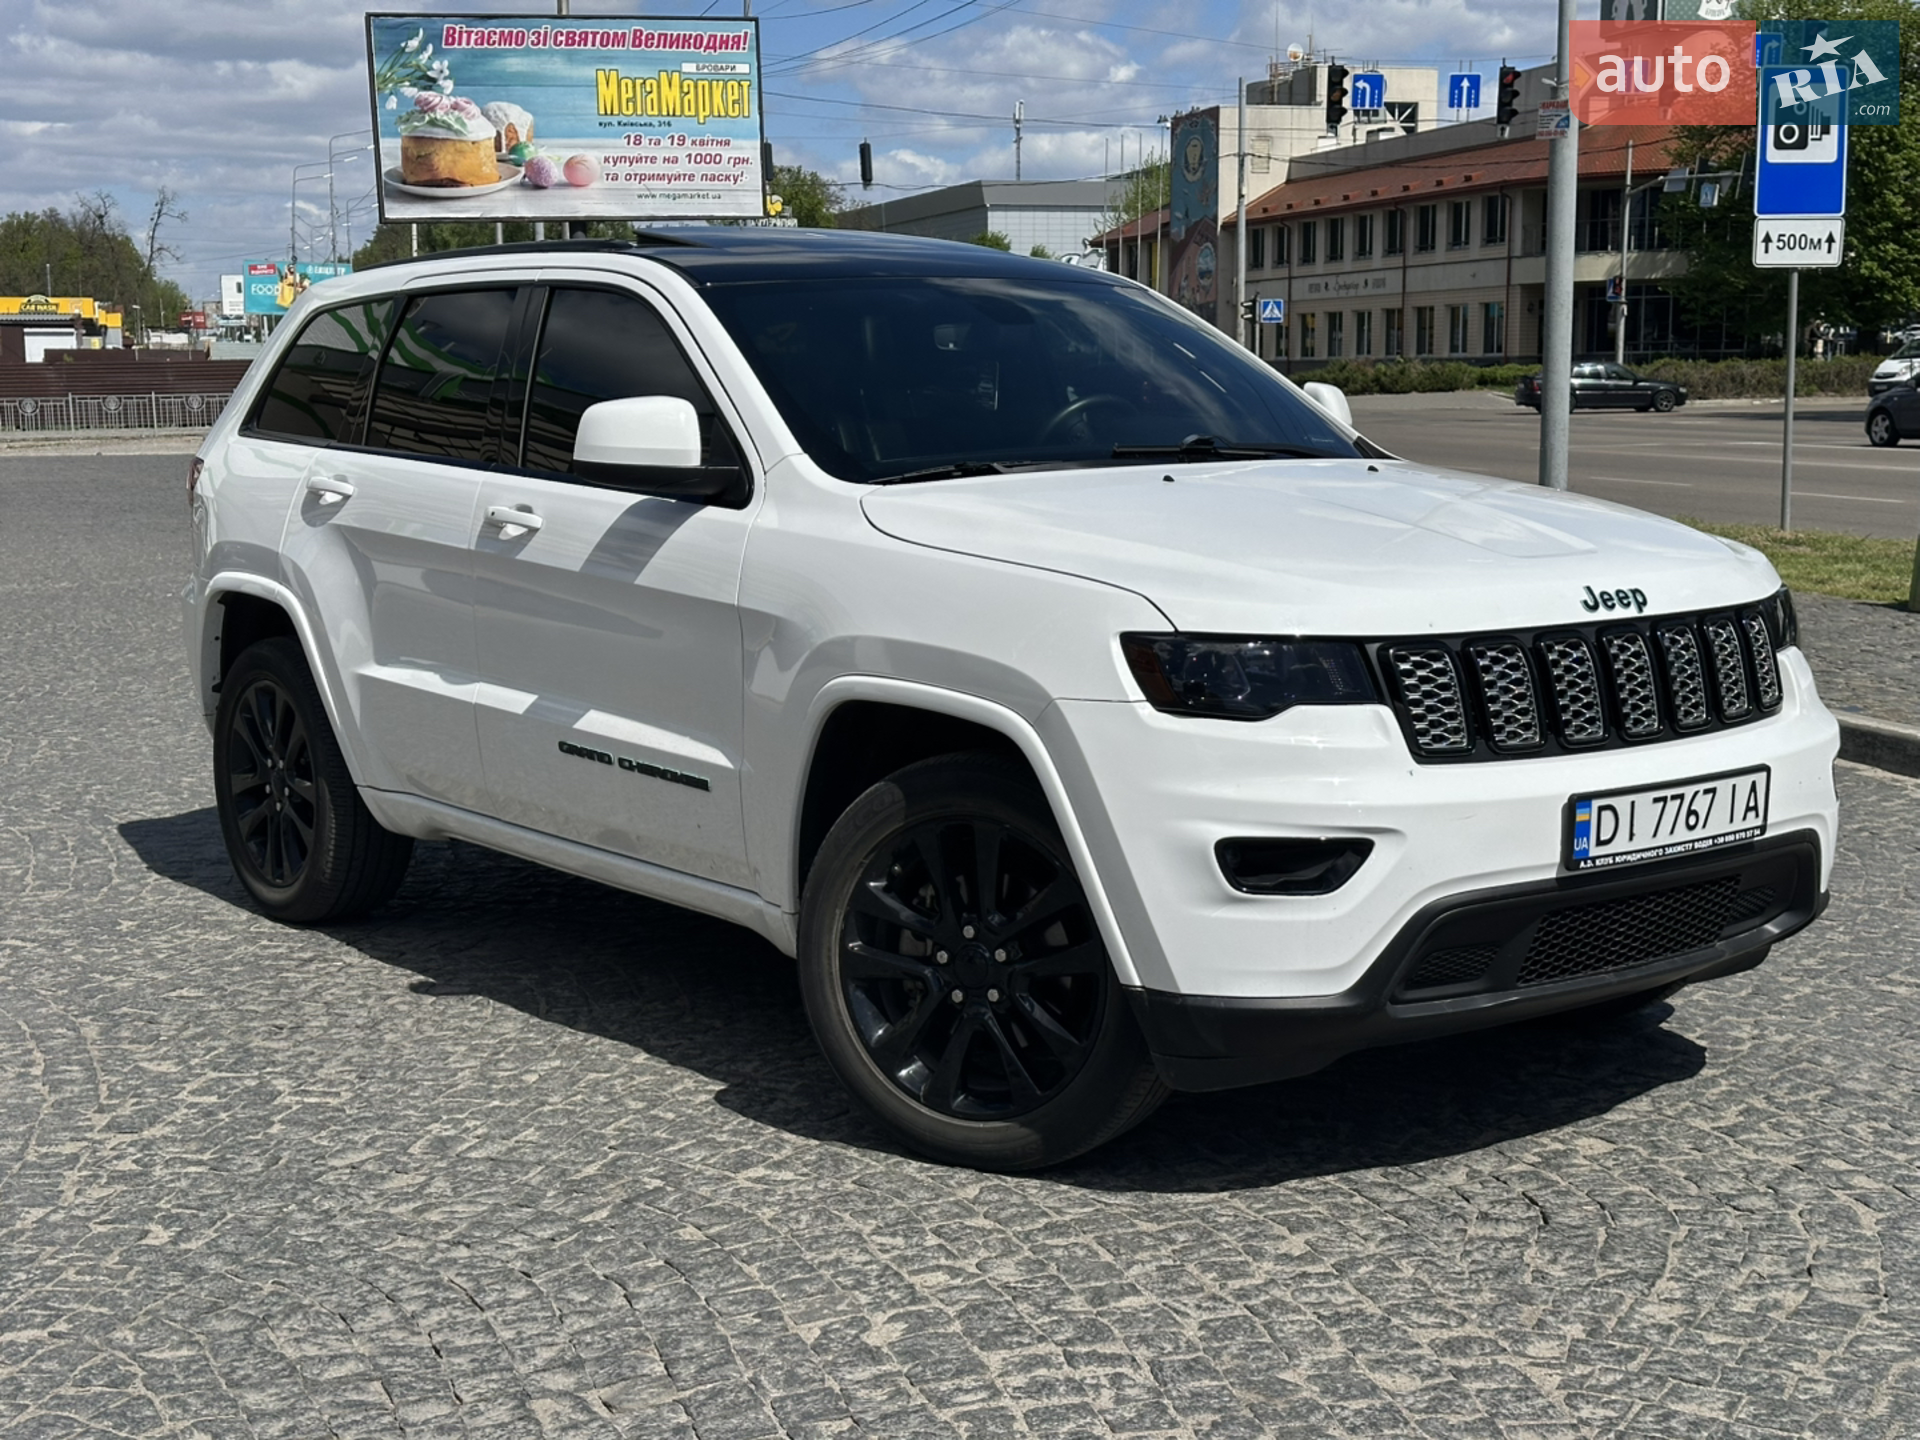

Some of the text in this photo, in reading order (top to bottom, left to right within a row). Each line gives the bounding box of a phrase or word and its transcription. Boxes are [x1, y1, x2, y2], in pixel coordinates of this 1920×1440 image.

[443, 25, 749, 52] Вітаємо зі святом Великодня!
[695, 63, 737, 73] БРОВАРИ
[596, 69, 752, 124] МегаМаркет
[623, 134, 731, 148] 18 та 19 квітня
[603, 152, 753, 168] купуйте на 1000 грн.
[604, 170, 745, 185] та отримуйте паску!
[1776, 233, 1823, 251] 500м
[1581, 585, 1648, 614] Jeep
[558, 740, 614, 766] GRAND
[1595, 780, 1760, 847] DI 7767 IA
[1574, 836, 1589, 852] UA
